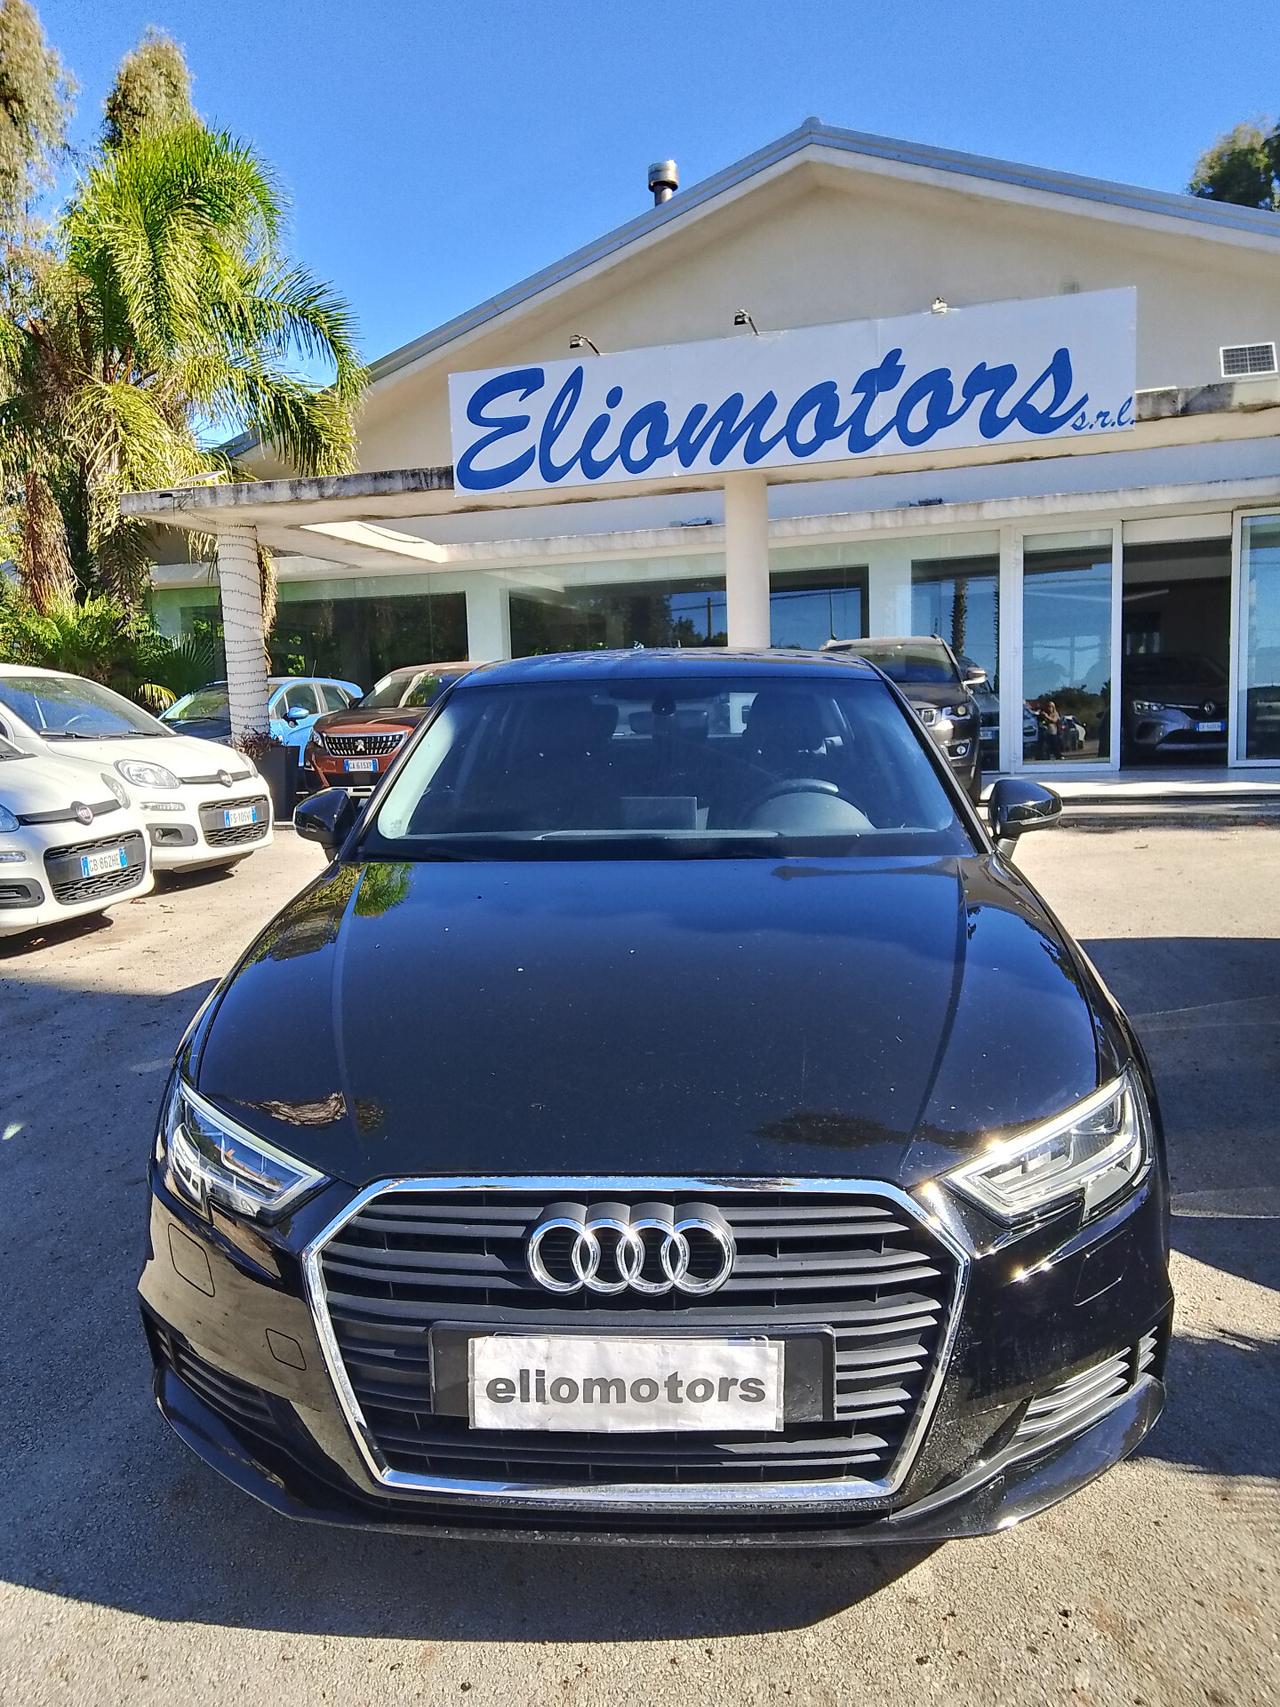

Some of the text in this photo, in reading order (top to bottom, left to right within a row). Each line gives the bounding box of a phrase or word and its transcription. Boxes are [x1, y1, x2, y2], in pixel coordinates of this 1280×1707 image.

[456, 347, 1137, 491] Eliomotors s.r.l.
[486, 1368, 766, 1405] eliomotors
